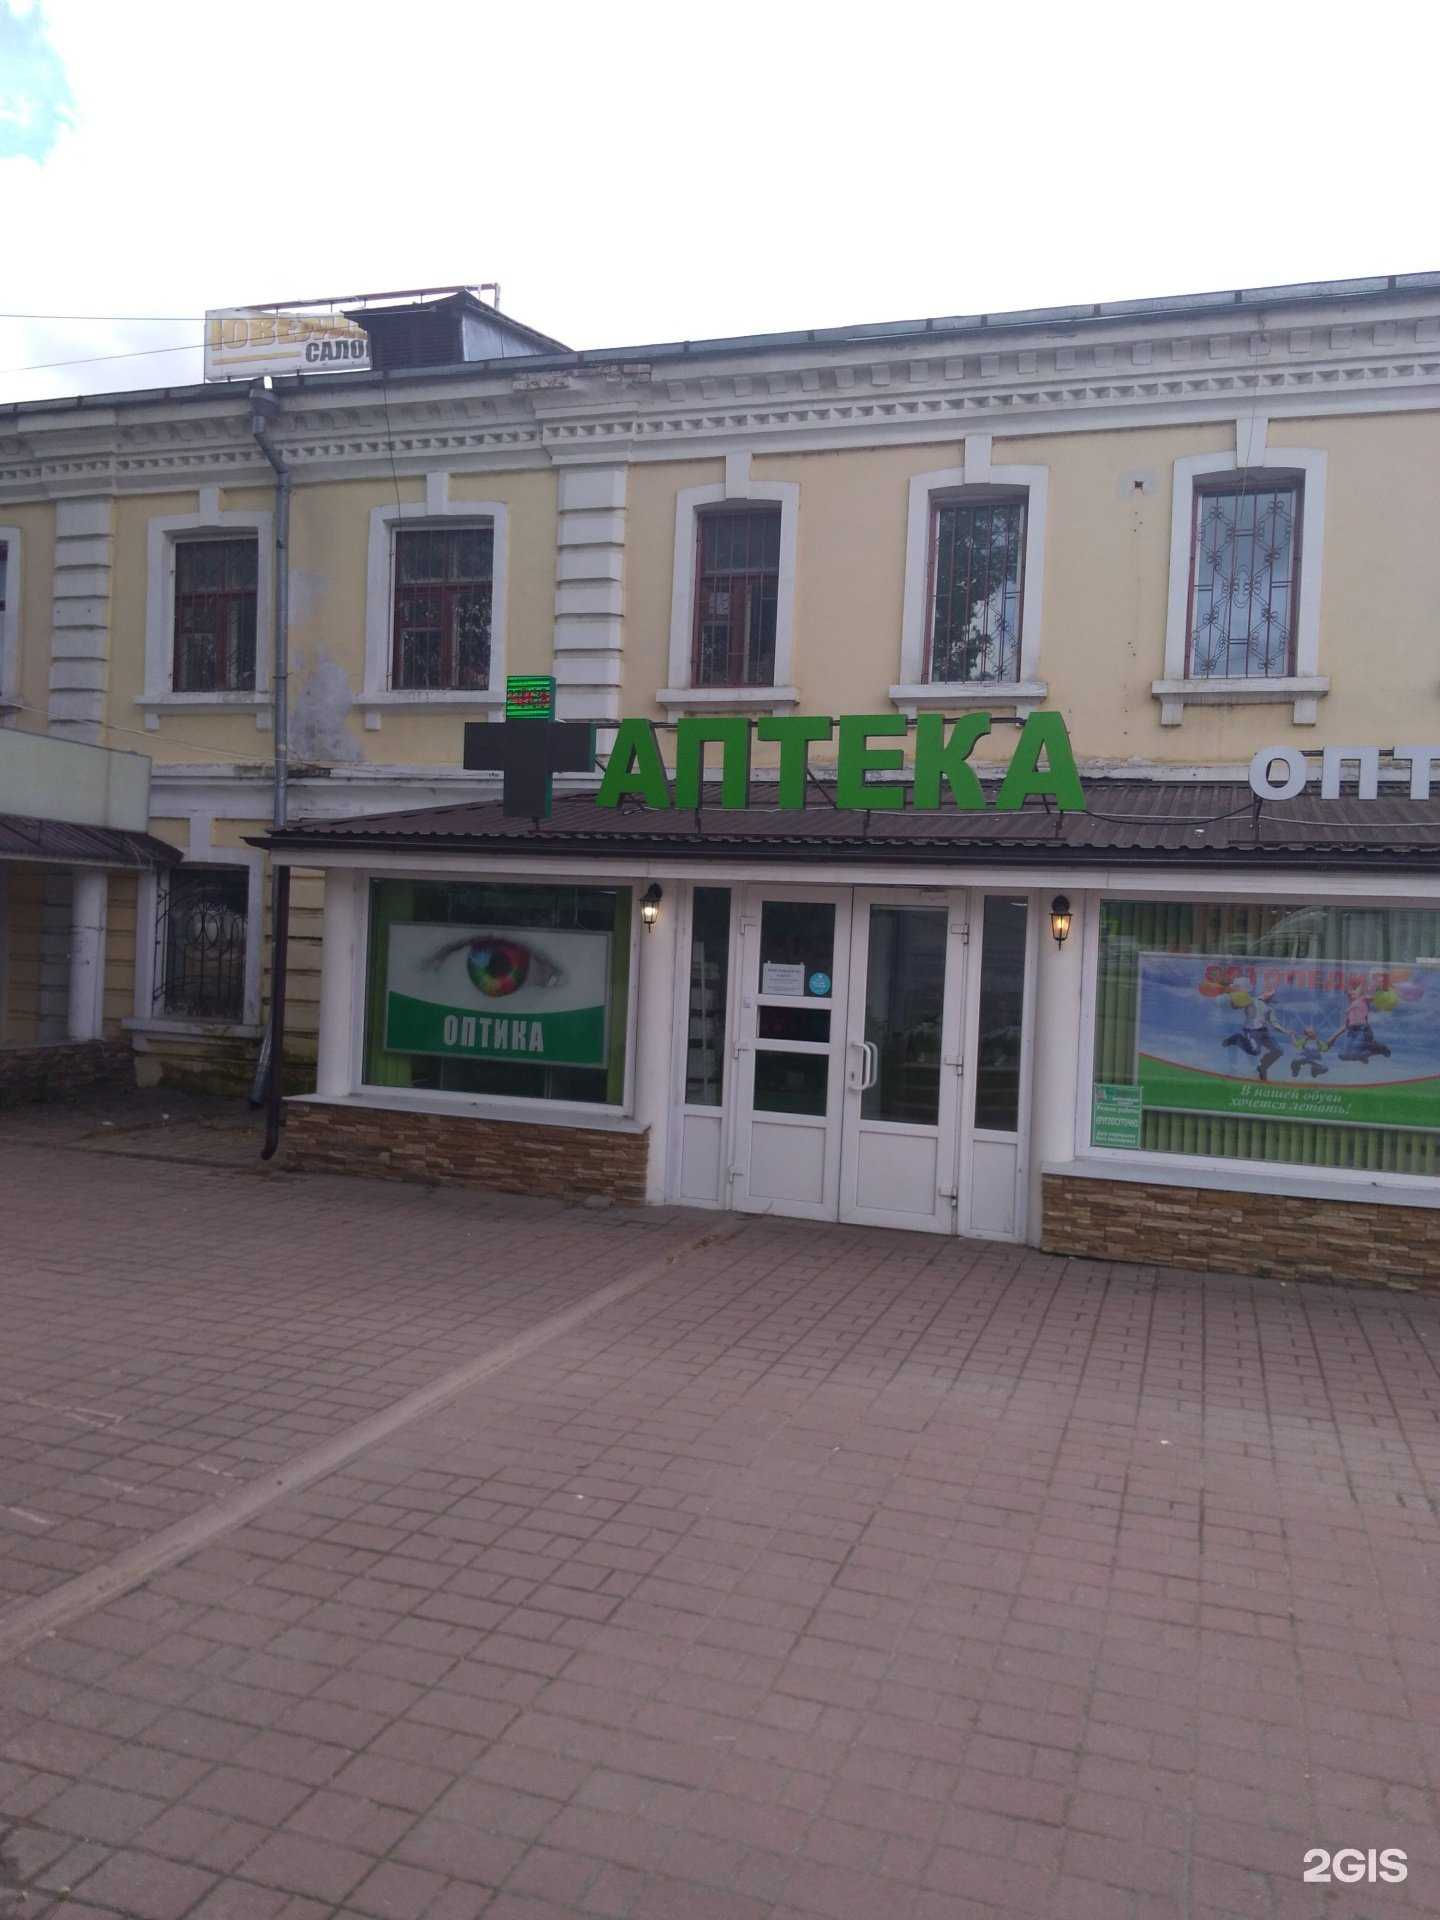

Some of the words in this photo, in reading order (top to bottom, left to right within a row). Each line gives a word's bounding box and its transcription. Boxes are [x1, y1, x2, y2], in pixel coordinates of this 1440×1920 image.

[305, 338, 370, 363] САЛО
[596, 711, 1087, 811] АПТЕКА
[1248, 745, 1440, 801] ОПТ
[443, 1014, 545, 1052] ОПТИКА
